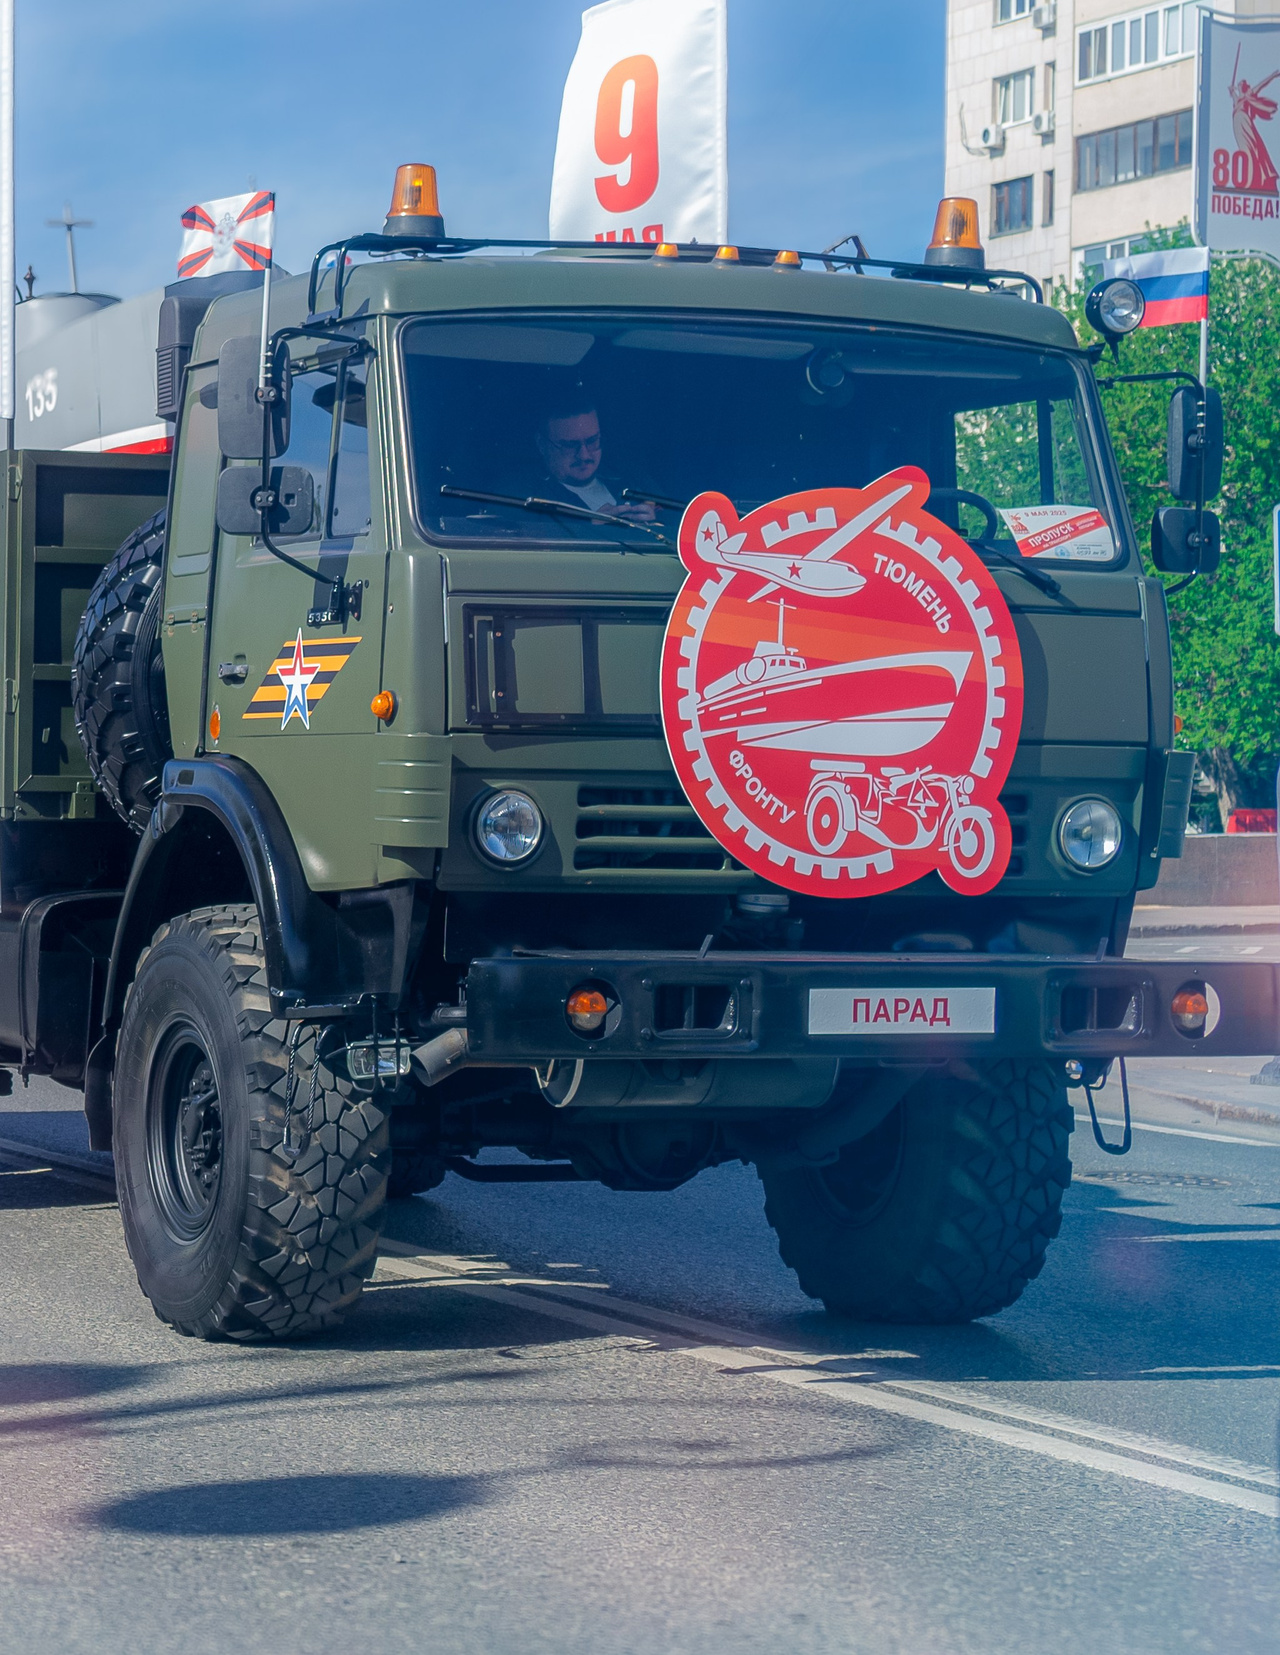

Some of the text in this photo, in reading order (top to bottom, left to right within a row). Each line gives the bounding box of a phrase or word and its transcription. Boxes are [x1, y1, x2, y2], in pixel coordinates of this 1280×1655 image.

[594, 54, 660, 214] 9
[1212, 148, 1250, 189] 80
[1211, 194, 1280, 221] ПОБЕДА!
[25, 371, 58, 422] 135
[1028, 523, 1075, 548] ПРОПУСК
[873, 552, 952, 634] ТЮМЕНЬ
[729, 750, 797, 824] ФРОНТУ
[852, 998, 951, 1027] ПАРАД
